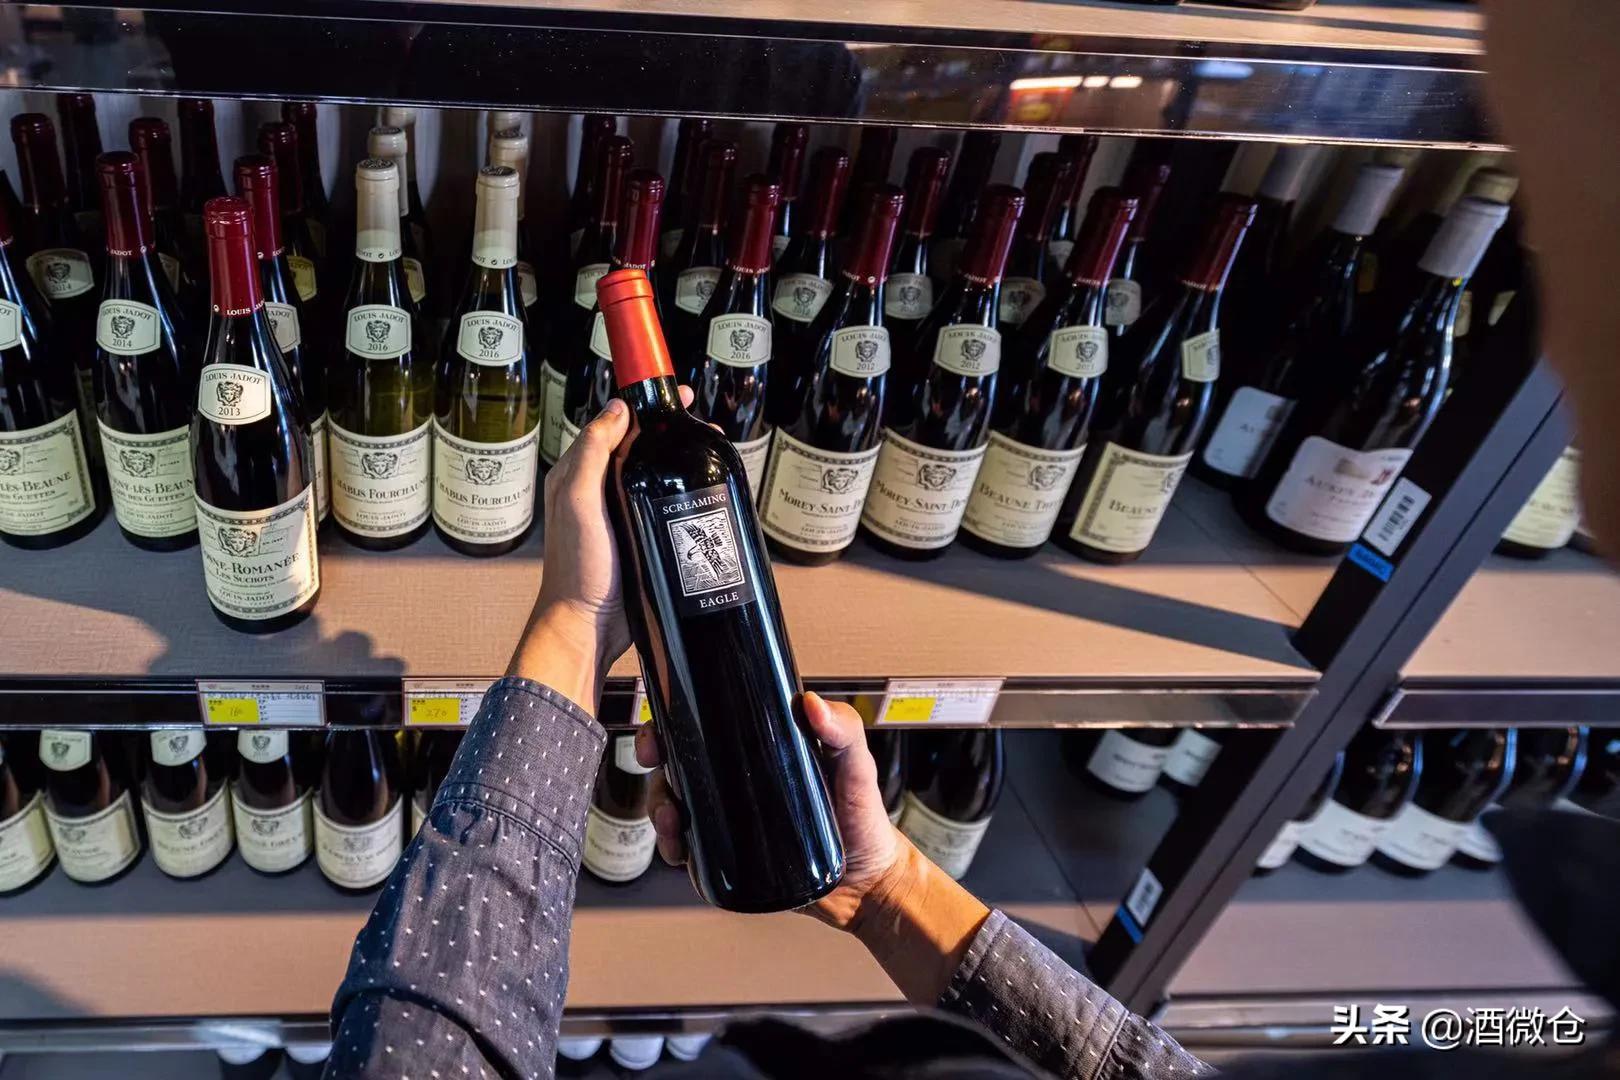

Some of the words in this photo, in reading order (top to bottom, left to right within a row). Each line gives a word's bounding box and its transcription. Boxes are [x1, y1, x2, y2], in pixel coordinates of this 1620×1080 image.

[101, 307, 122, 317] LOUIS
[123, 308, 152, 321] JADOT
[226, 307, 252, 317] LOUIS
[353, 312, 377, 322] LOUIS
[378, 311, 404, 323] JADOT
[466, 318, 491, 327] LOUIS
[717, 321, 743, 330] LOUIS
[111, 338, 132, 349] 2014
[841, 333, 868, 343] LOUIS
[367, 342, 389, 352] 2016
[478, 349, 500, 358] 2016
[730, 351, 751, 360] 2016
[855, 362, 876, 371] 2012
[960, 360, 981, 370] 2012
[205, 371, 229, 383] LOUIS
[229, 372, 263, 385] JADOT
[217, 406, 241, 417] 2013
[13, 490, 56, 501] GUETTES
[144, 491, 186, 502] GUETTES
[978, 482, 1031, 510] BEAUNE
[662, 493, 727, 515] SCREAMING
[215, 569, 232, 581] LES
[232, 573, 275, 584] SUCHOTS
[218, 589, 244, 601] LOUIS
[244, 593, 275, 602] JADOT
[699, 591, 739, 609] EAGLE
